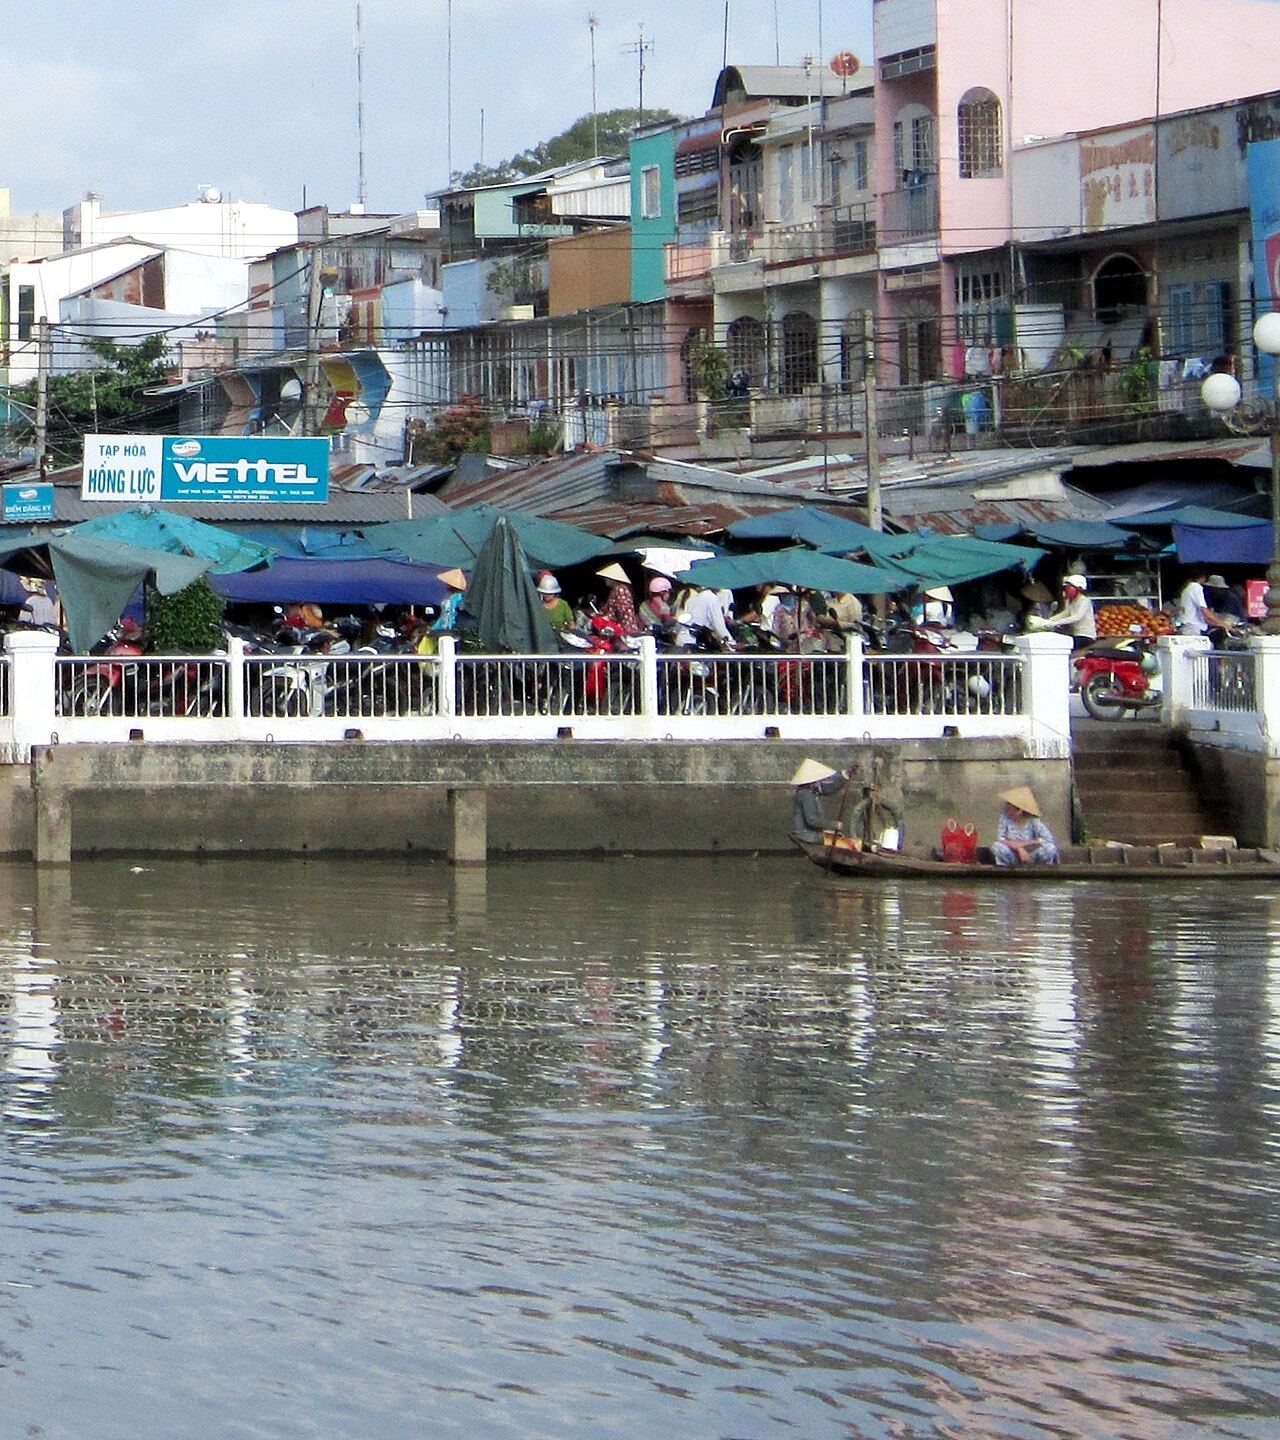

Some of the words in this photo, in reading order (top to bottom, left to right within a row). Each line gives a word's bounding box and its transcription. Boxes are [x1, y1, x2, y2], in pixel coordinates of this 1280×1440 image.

[99, 444, 120, 459] TẠP
[88, 460, 125, 494] HỒNG
[130, 467, 155, 499] LỰC
[173, 459, 319, 484] VIETTEL
